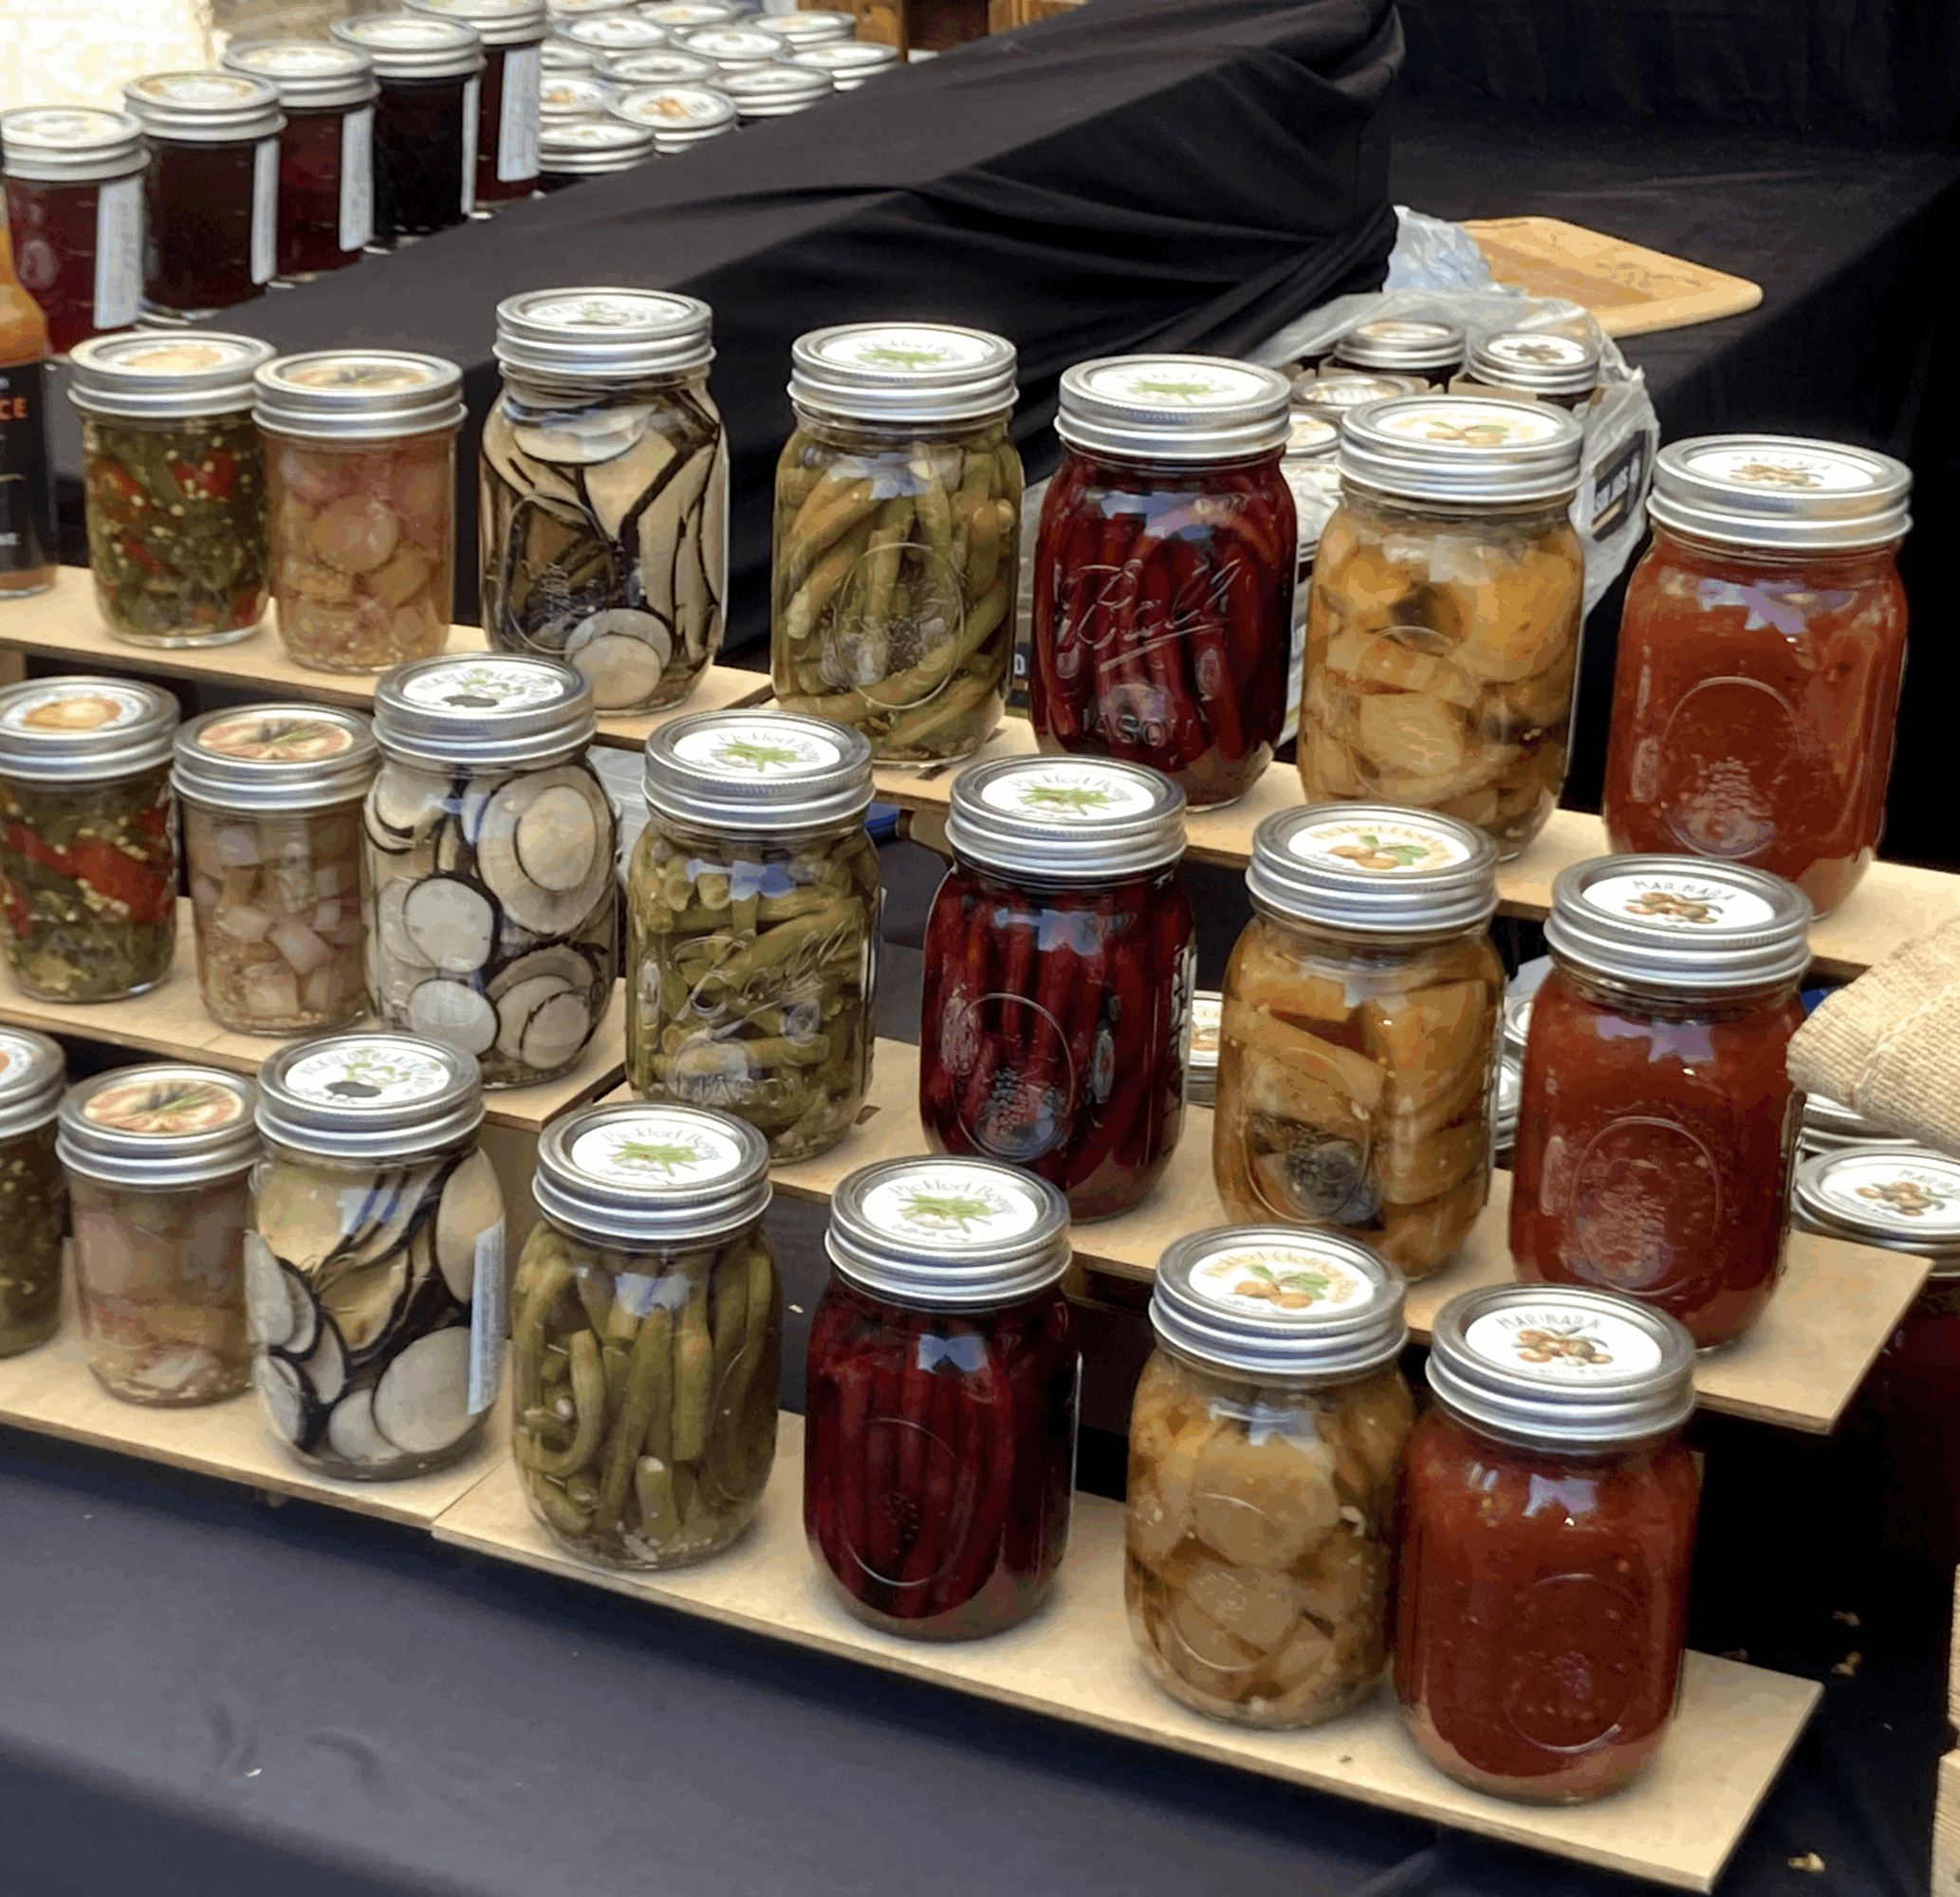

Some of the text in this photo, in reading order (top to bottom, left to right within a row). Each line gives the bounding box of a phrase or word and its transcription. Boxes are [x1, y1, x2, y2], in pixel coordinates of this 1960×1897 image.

[1632, 879, 1738, 901] MARINARA
[887, 1179, 972, 1197] Pickled
[1493, 1313, 1603, 1331] MARINARA
